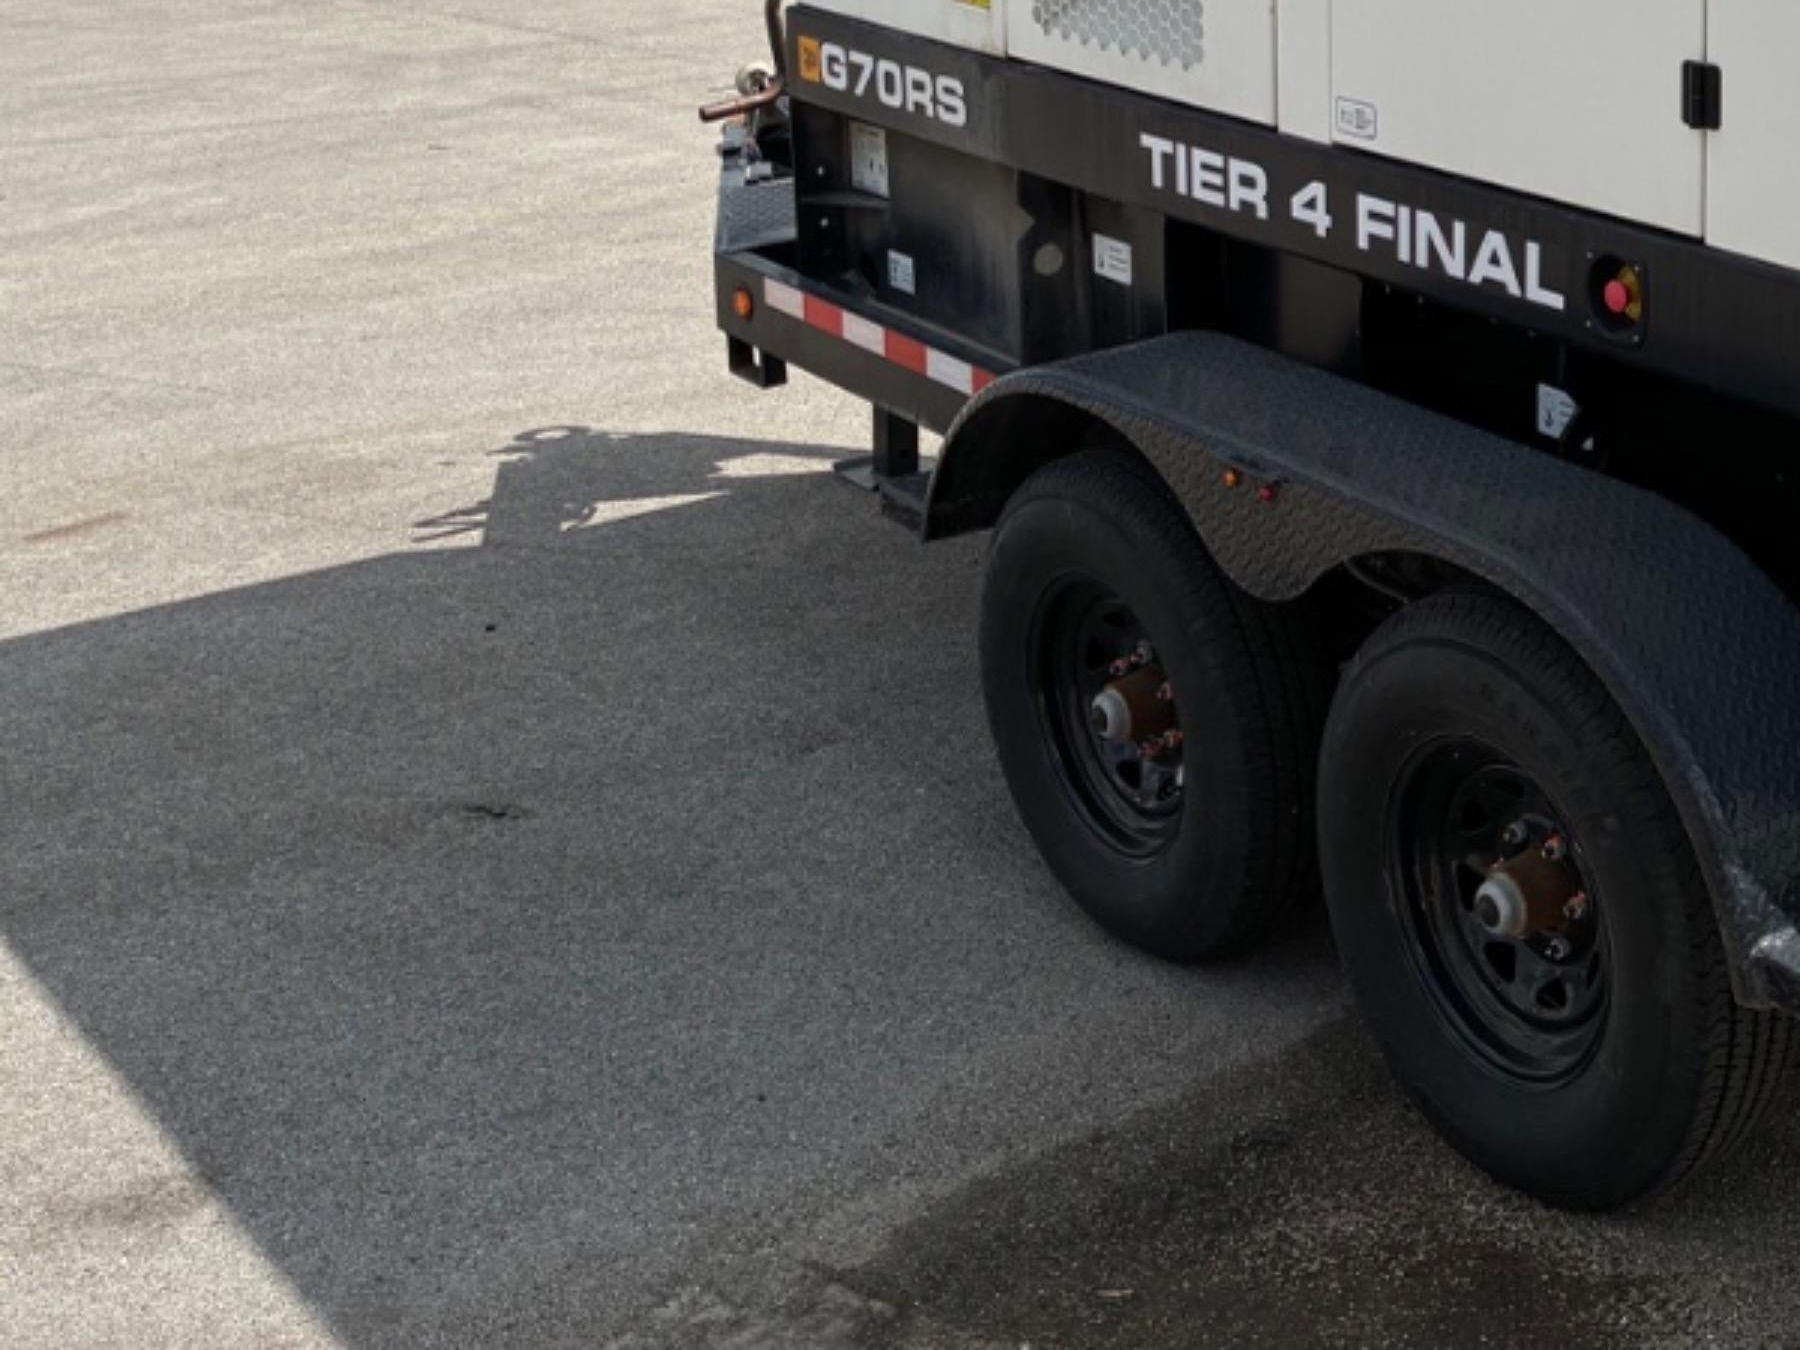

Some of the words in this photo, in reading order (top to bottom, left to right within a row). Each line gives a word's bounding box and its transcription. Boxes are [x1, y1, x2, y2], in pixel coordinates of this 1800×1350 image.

[821, 42, 967, 127] G70RS
[1140, 133, 1268, 219] TIER
[1290, 182, 1332, 238] 4
[1357, 193, 1564, 310] FINAL
